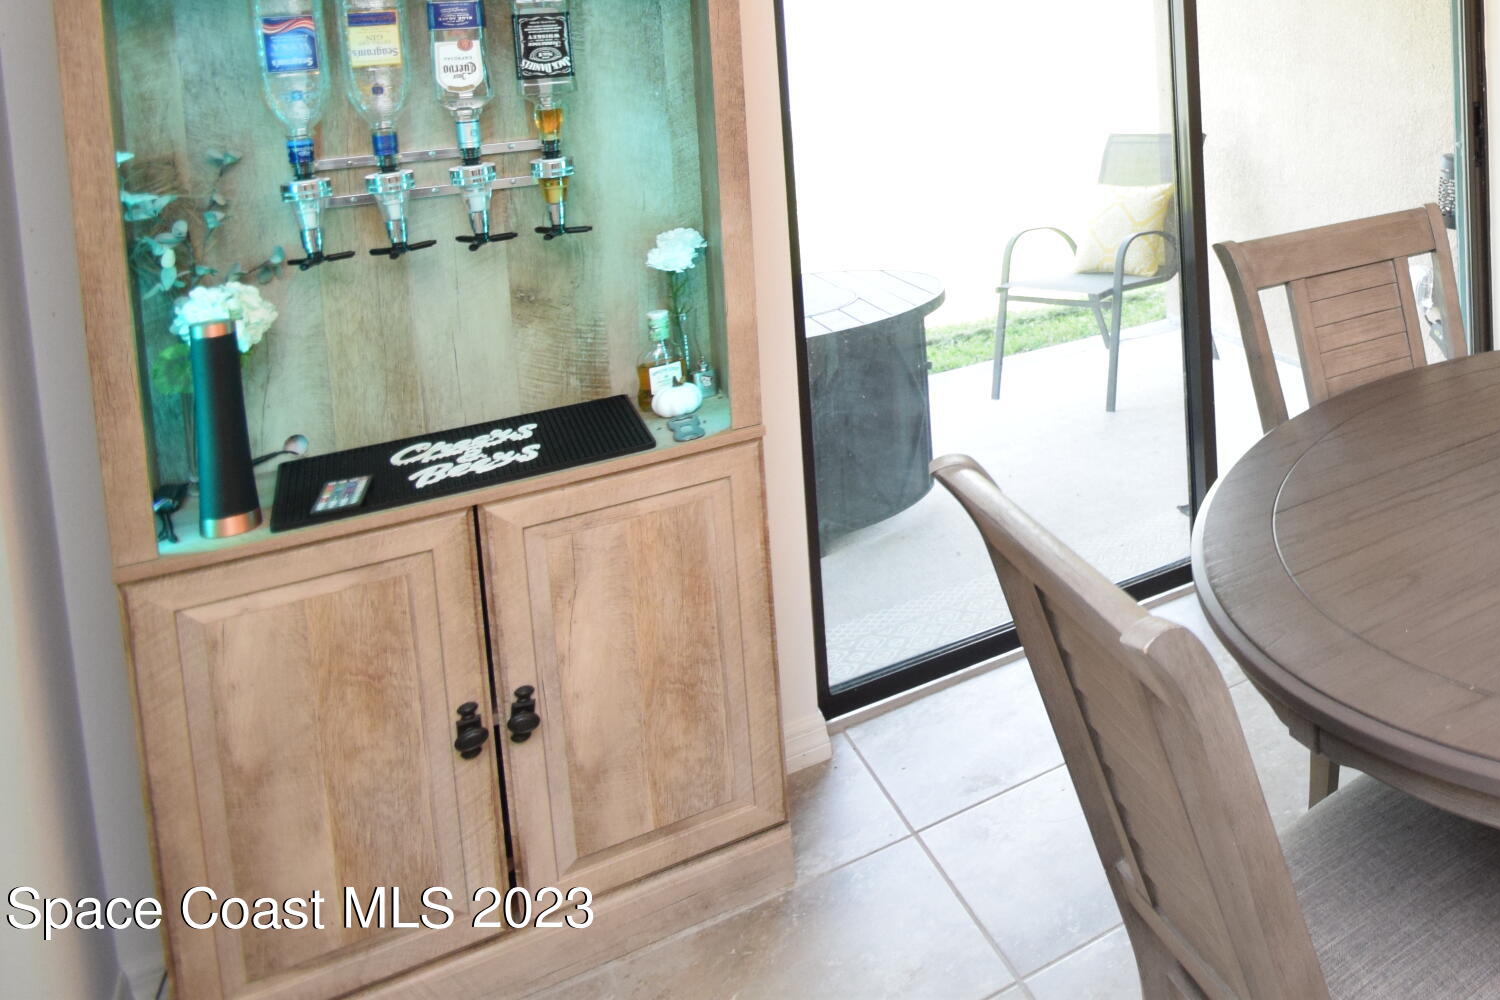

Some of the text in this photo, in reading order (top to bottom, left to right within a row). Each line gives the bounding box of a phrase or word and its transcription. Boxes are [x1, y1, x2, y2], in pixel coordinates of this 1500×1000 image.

[442, 61, 477, 75] Cuervo
[552, 56, 572, 71] JACK
[390, 423, 538, 467] Cheers
